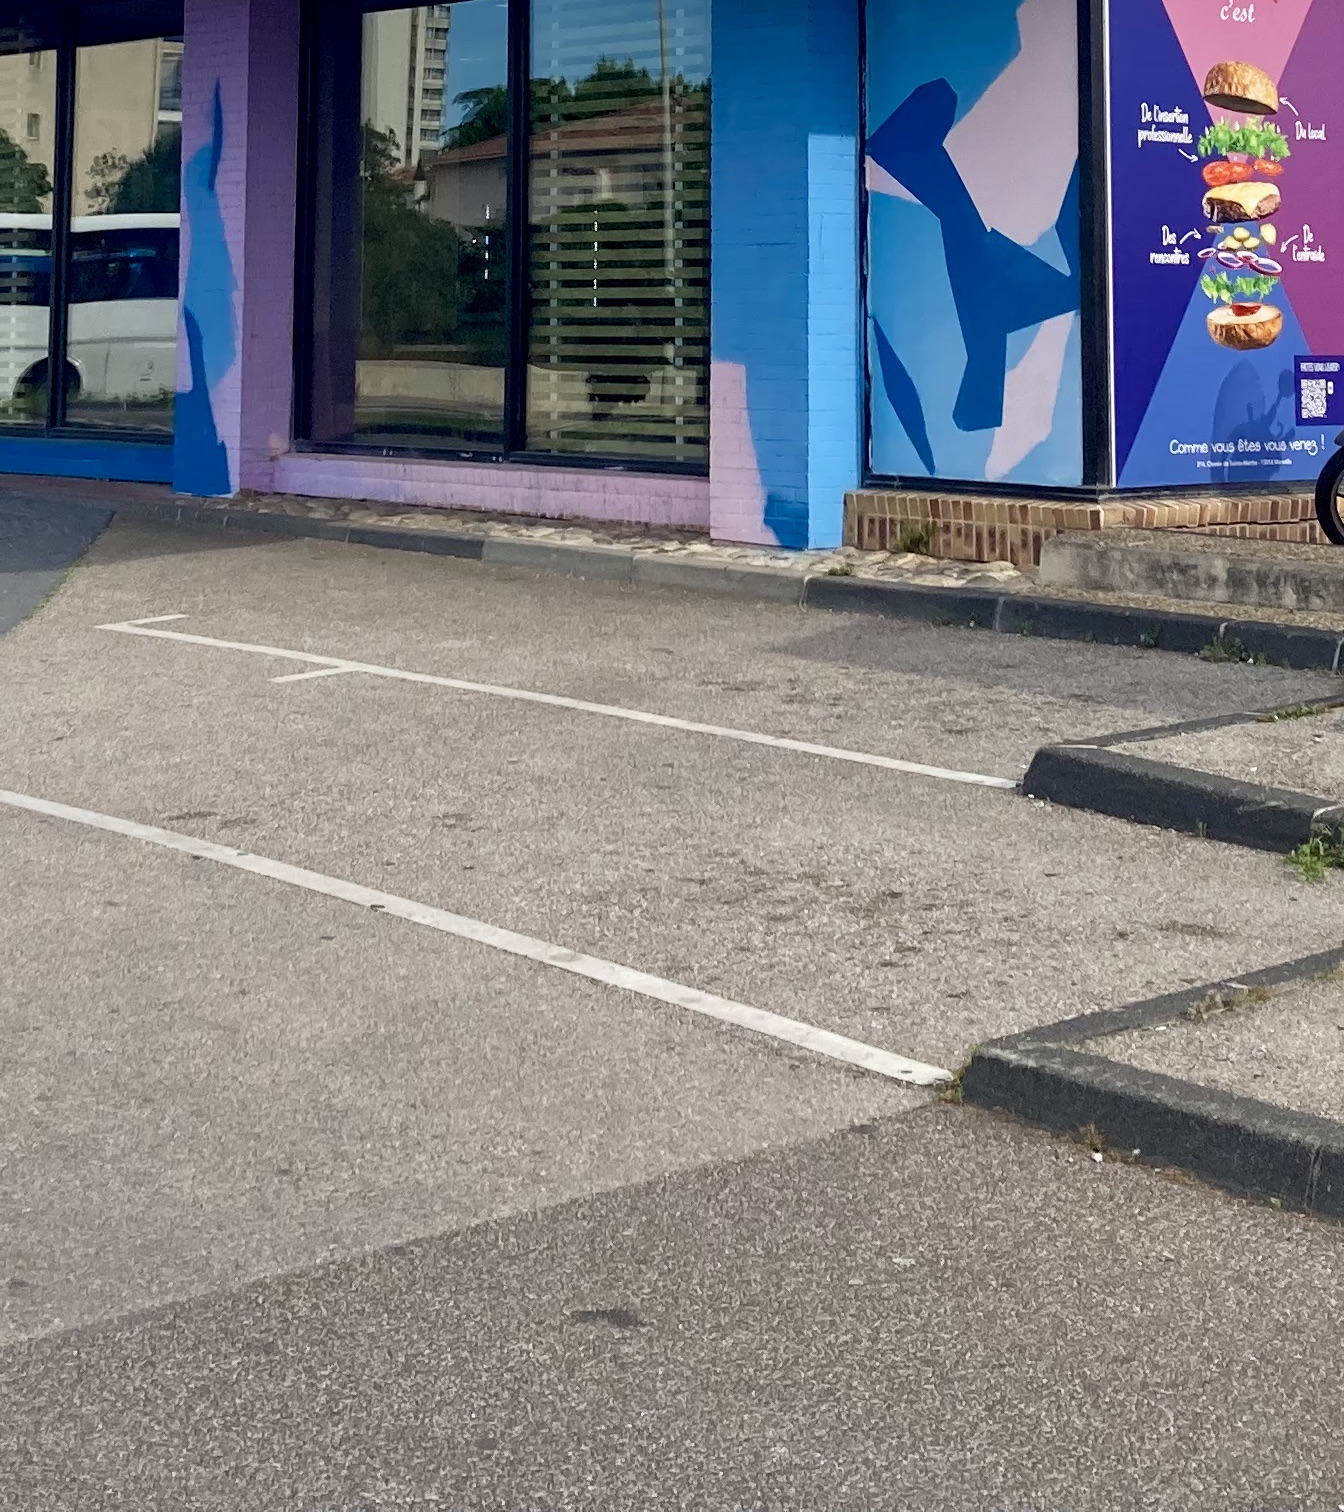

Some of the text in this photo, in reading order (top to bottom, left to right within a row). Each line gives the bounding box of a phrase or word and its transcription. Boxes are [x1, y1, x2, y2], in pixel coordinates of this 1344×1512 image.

[1141, 102, 1152, 123] De
[1169, 439, 1209, 455] Comme
[1211, 441, 1235, 453] vous
[1237, 438, 1261, 453] êtes
[1263, 440, 1287, 452] vous
[1288, 438, 1319, 456] venez
